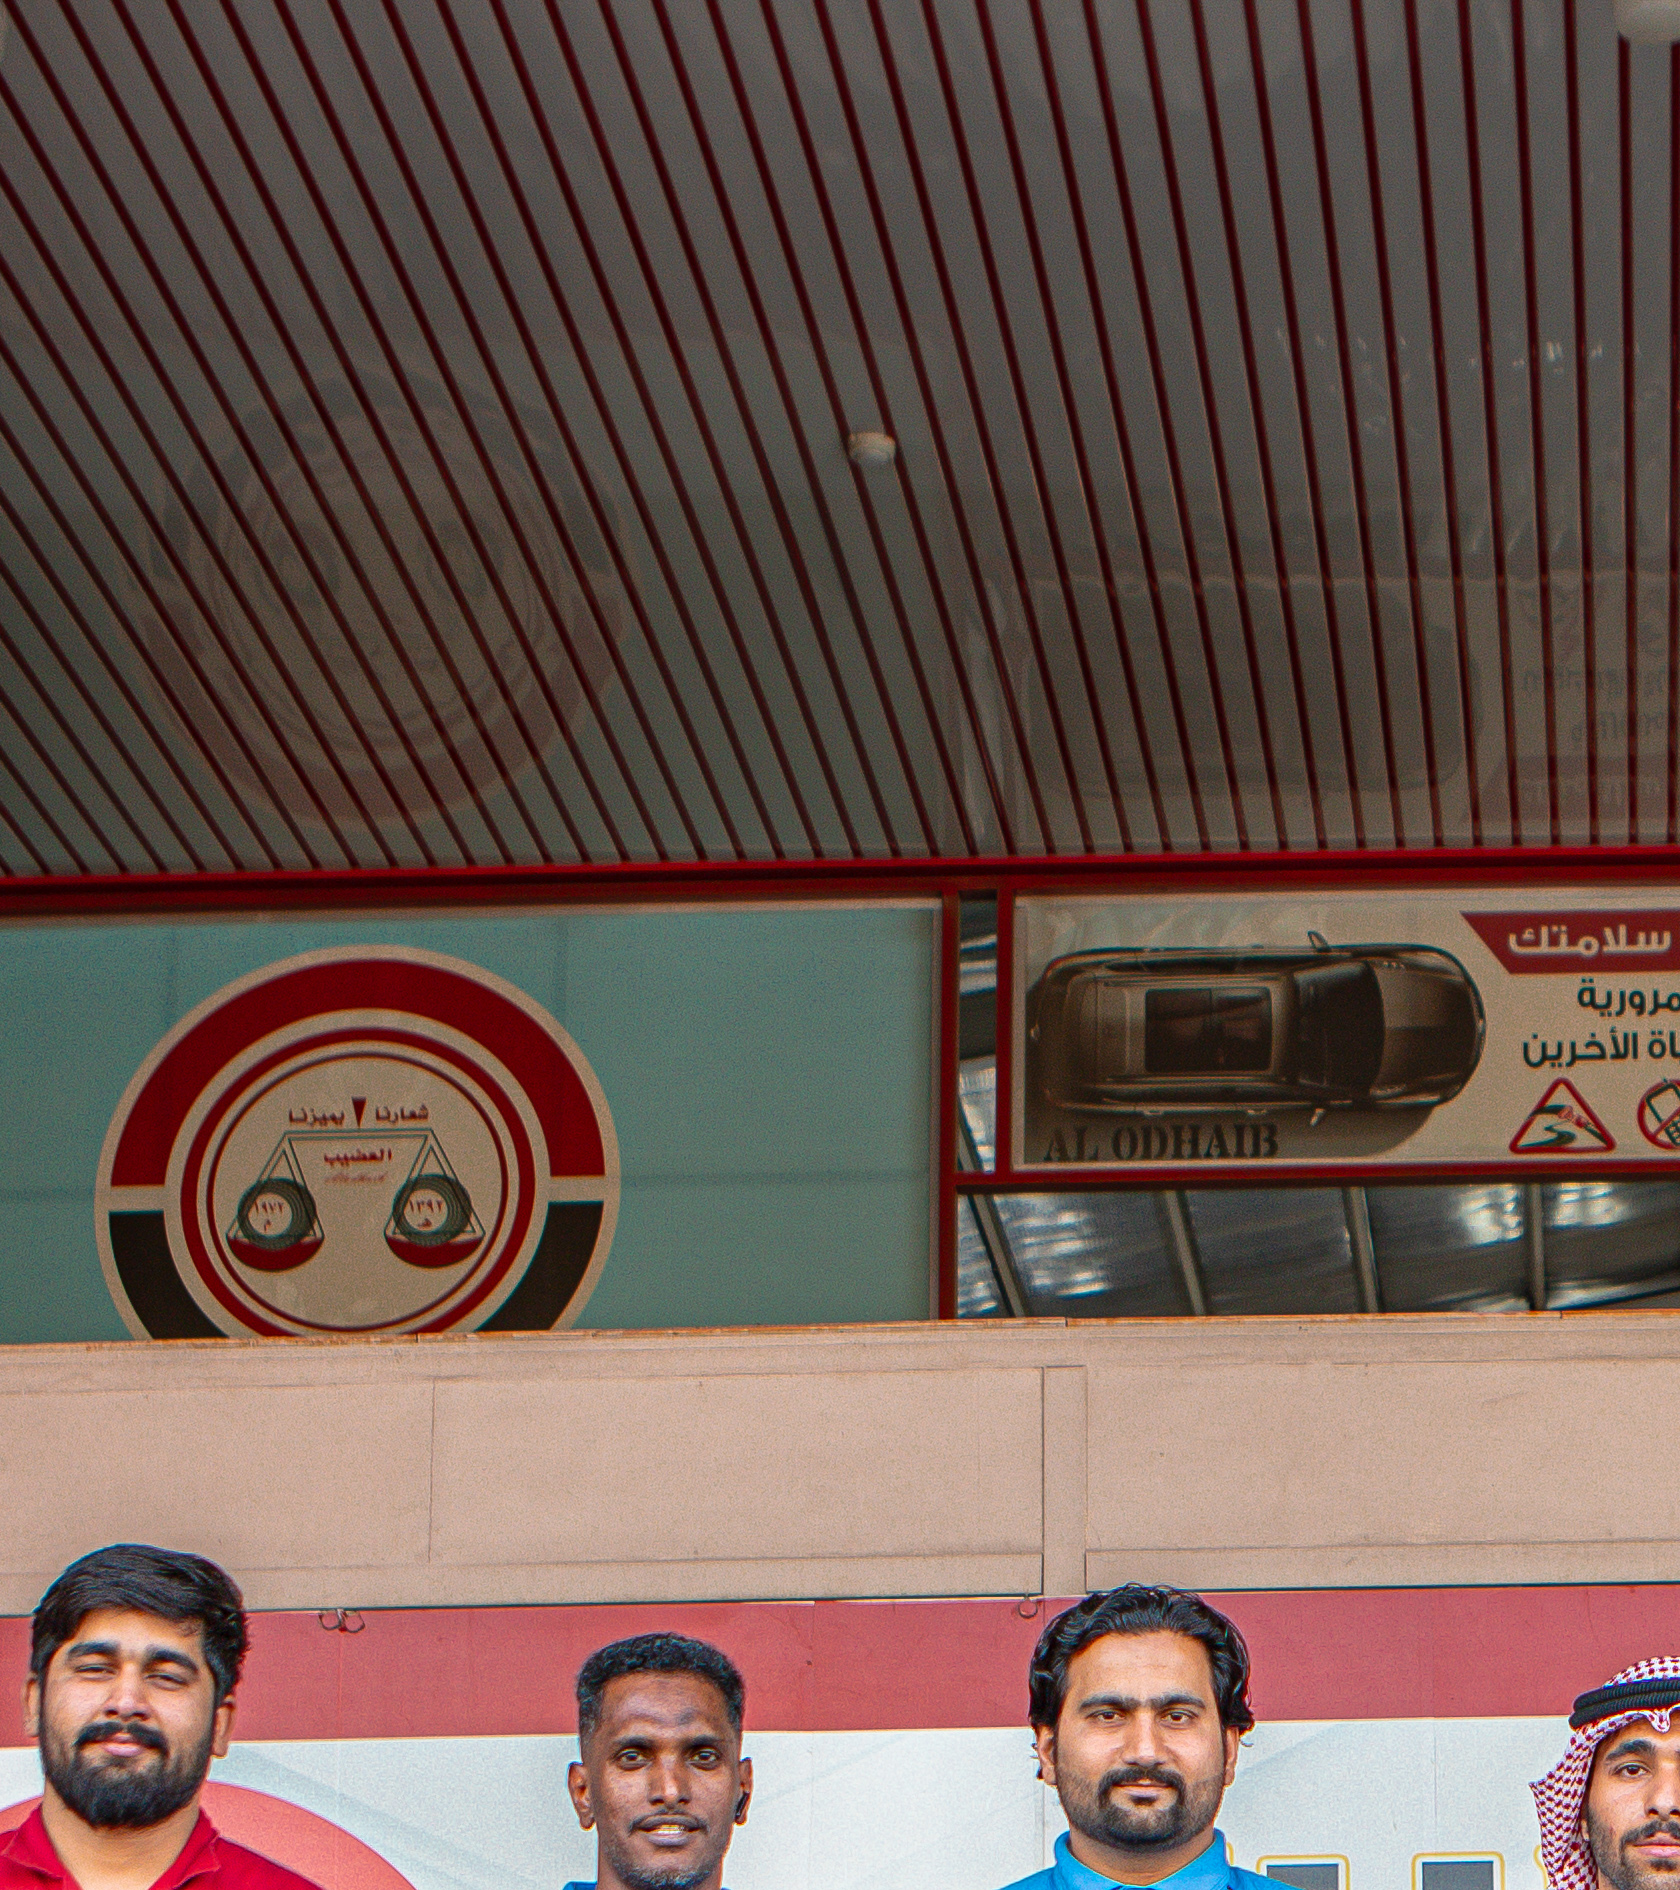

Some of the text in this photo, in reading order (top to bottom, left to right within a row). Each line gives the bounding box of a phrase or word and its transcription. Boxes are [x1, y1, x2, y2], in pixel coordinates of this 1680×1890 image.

[1507, 921, 1672, 957] سلامتك
[1522, 1027, 1640, 1069] الأخرين
[288, 1102, 429, 1127] شعارنا يميزنا
[323, 1148, 392, 1169] العضيب
[1043, 1122, 1279, 1162] AL ODHAIB
